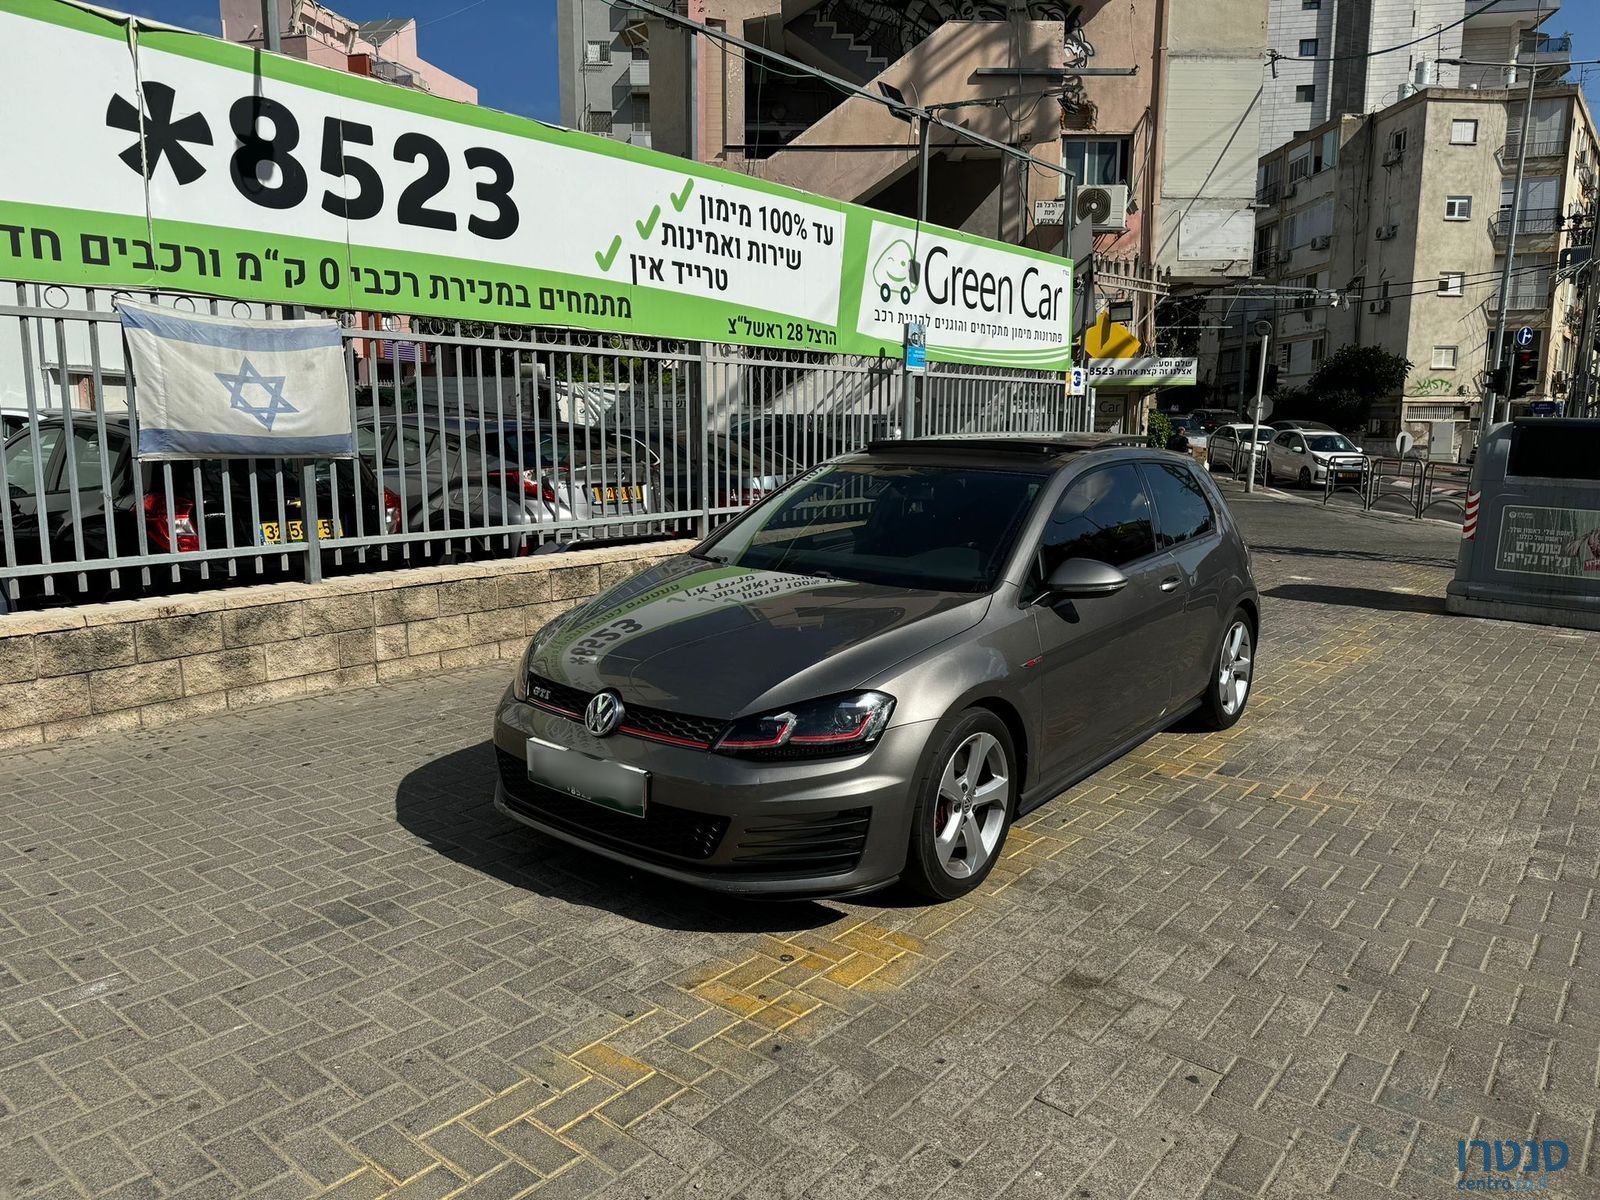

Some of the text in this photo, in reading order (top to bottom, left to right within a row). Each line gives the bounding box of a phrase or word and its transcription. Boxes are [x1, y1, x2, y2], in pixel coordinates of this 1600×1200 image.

[699, 194, 834, 246] עד 100% מימון
[79, 233, 221, 278] ורכבים
[661, 222, 802, 270] שירות ואמינות
[235, 248, 306, 289] ק"מ
[319, 257, 340, 290] 0
[350, 266, 420, 298] רכבי
[630, 253, 729, 291] טרייד אין
[924, 246, 1063, 321] Green Car
[429, 274, 531, 308] במכירת
[539, 287, 632, 319] מתמחים
[727, 314, 837, 346] הרצל 28 ראשל"צ
[873, 308, 894, 323] רכב
[934, 317, 967, 332] והוגנים
[970, 322, 1009, 338] מתקדמים
[1011, 326, 1032, 341] מימון
[1033, 330, 1063, 343] פתרונות
[1089, 367, 1115, 376] 8523
[1159, 368, 1169, 376] זה
[1174, 359, 1193, 368] שלם
[532, 685, 552, 700] GTI
